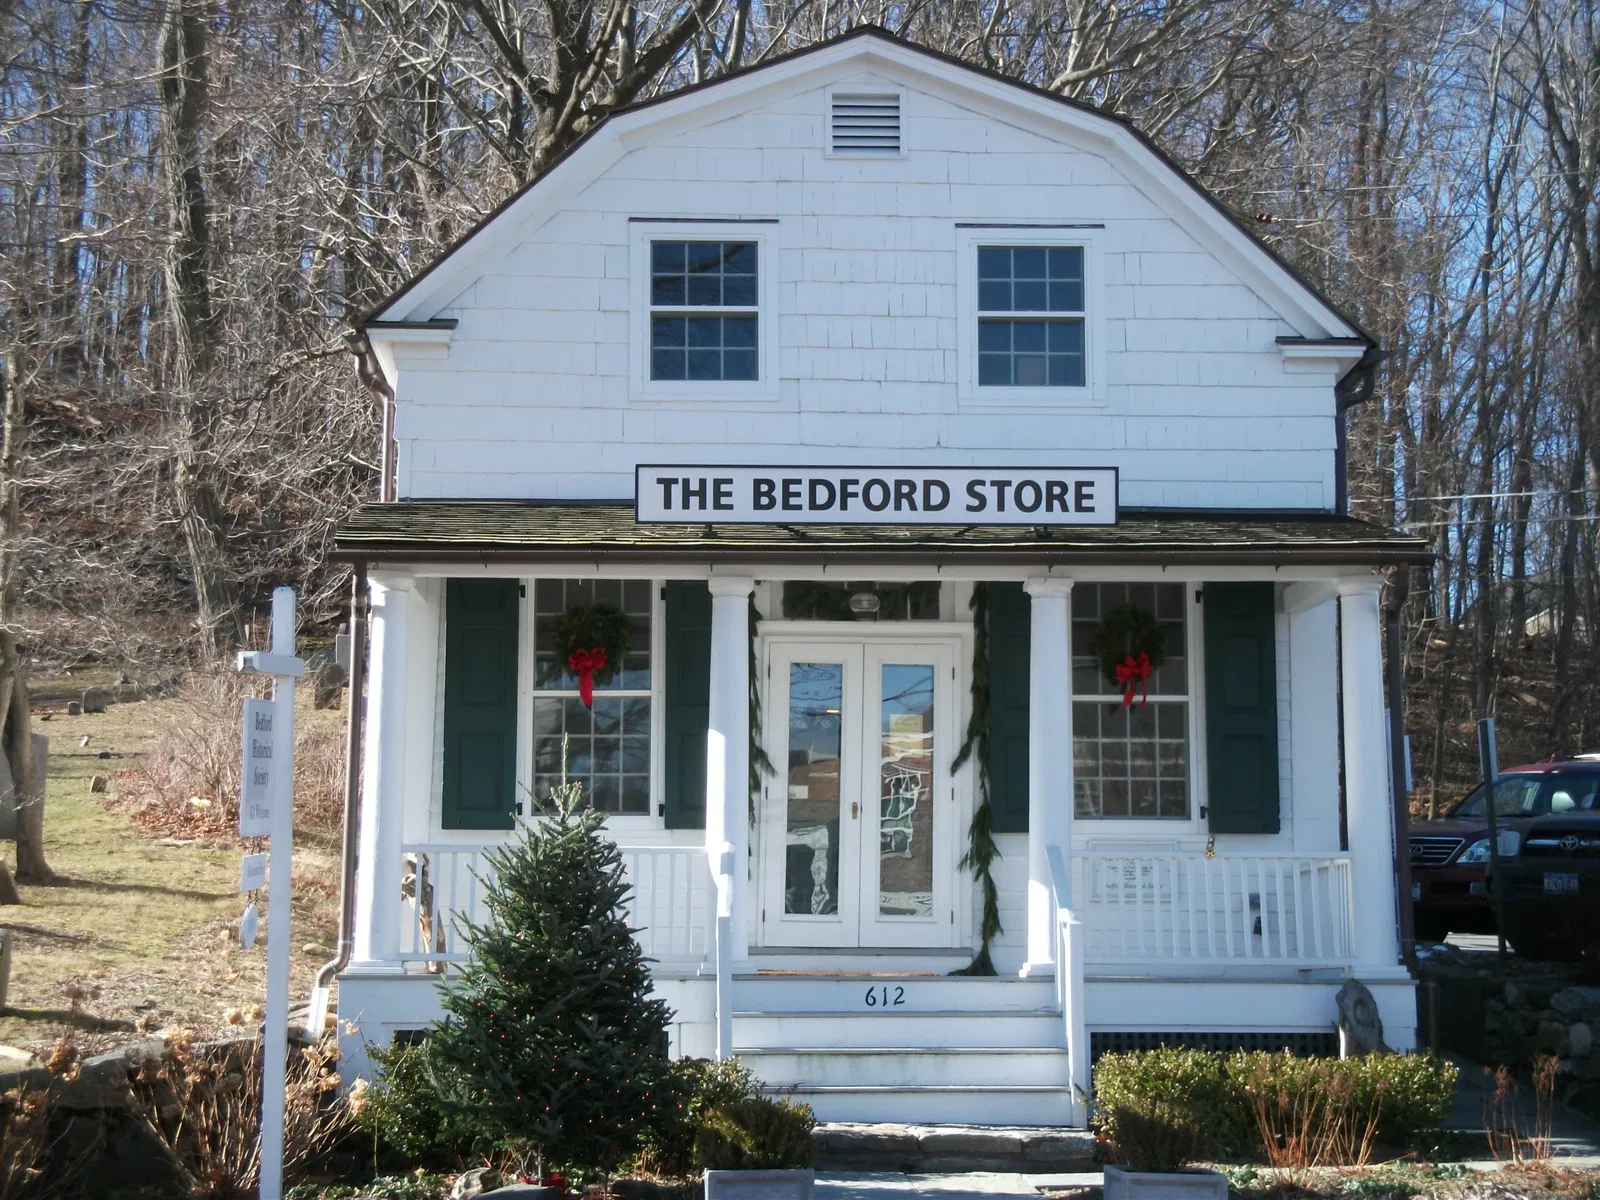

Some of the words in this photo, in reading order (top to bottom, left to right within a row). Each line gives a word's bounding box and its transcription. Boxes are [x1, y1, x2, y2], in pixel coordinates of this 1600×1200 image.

[656, 477, 734, 511] THE
[752, 478, 951, 512] BEDFORD
[965, 479, 1096, 513] STORE
[865, 986, 905, 1007] 612
